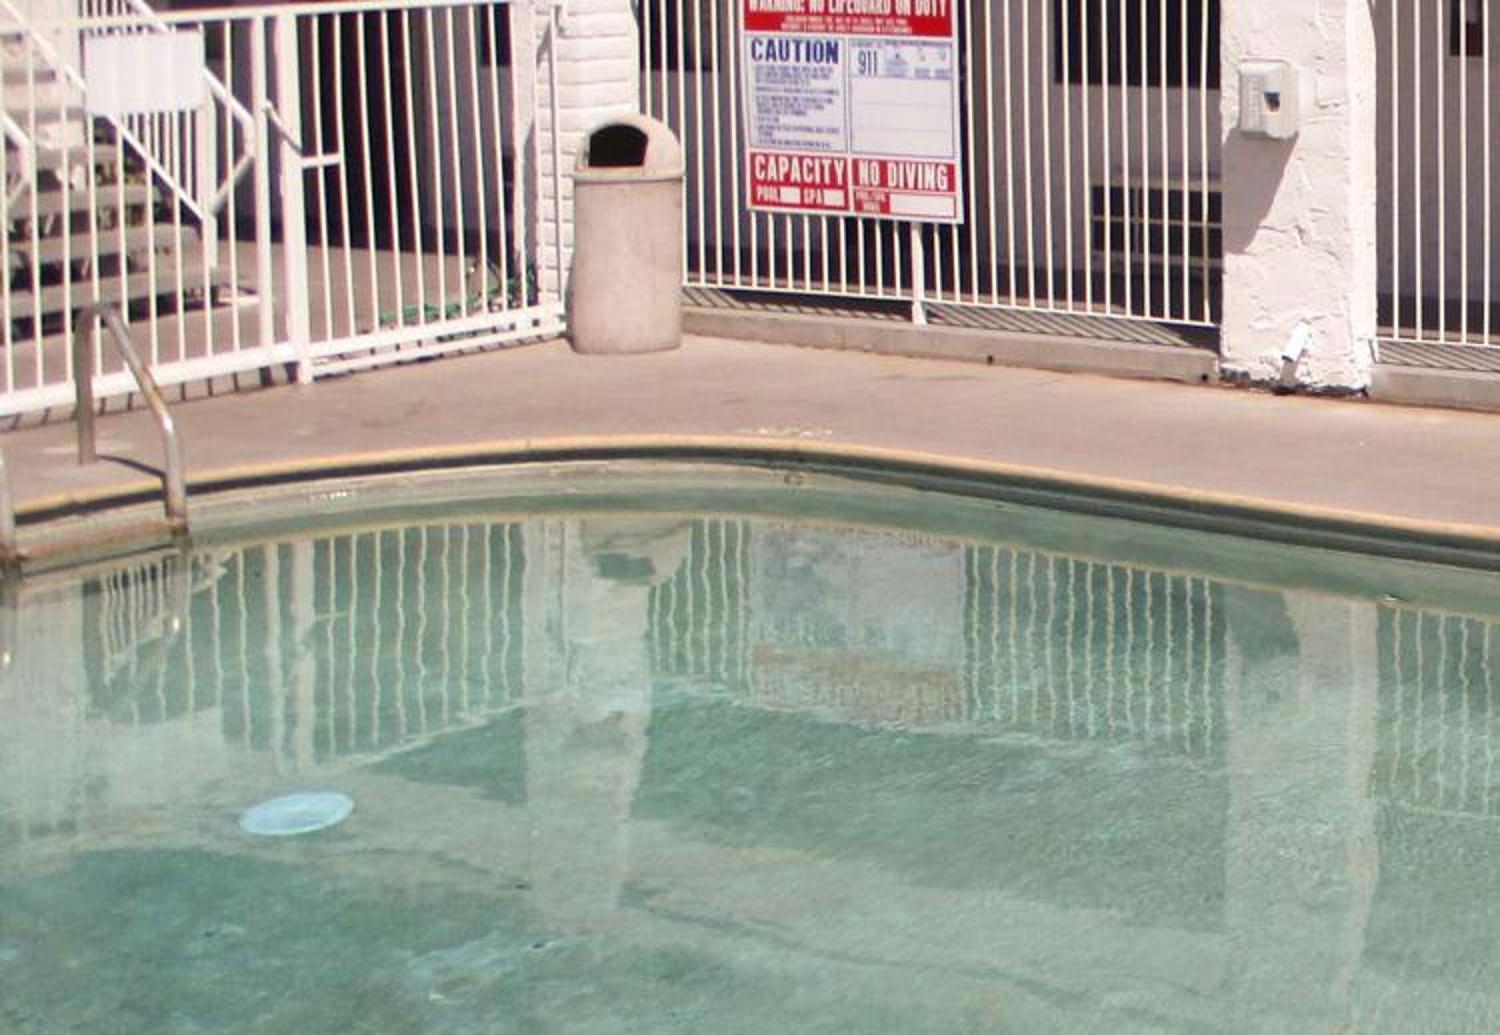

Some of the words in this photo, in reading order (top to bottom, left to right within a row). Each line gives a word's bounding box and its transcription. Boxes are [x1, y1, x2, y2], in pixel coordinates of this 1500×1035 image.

[809, 0, 826, 14] NO
[895, 0, 911, 16] ON
[915, 0, 947, 17] DUTY
[751, 37, 839, 64] CAUTION
[858, 49, 877, 77] 911
[755, 154, 845, 186] CAPACITY
[859, 160, 881, 186] NO
[887, 162, 948, 191] DIVING
[756, 185, 780, 202] POOL
[803, 188, 822, 205] SPA
